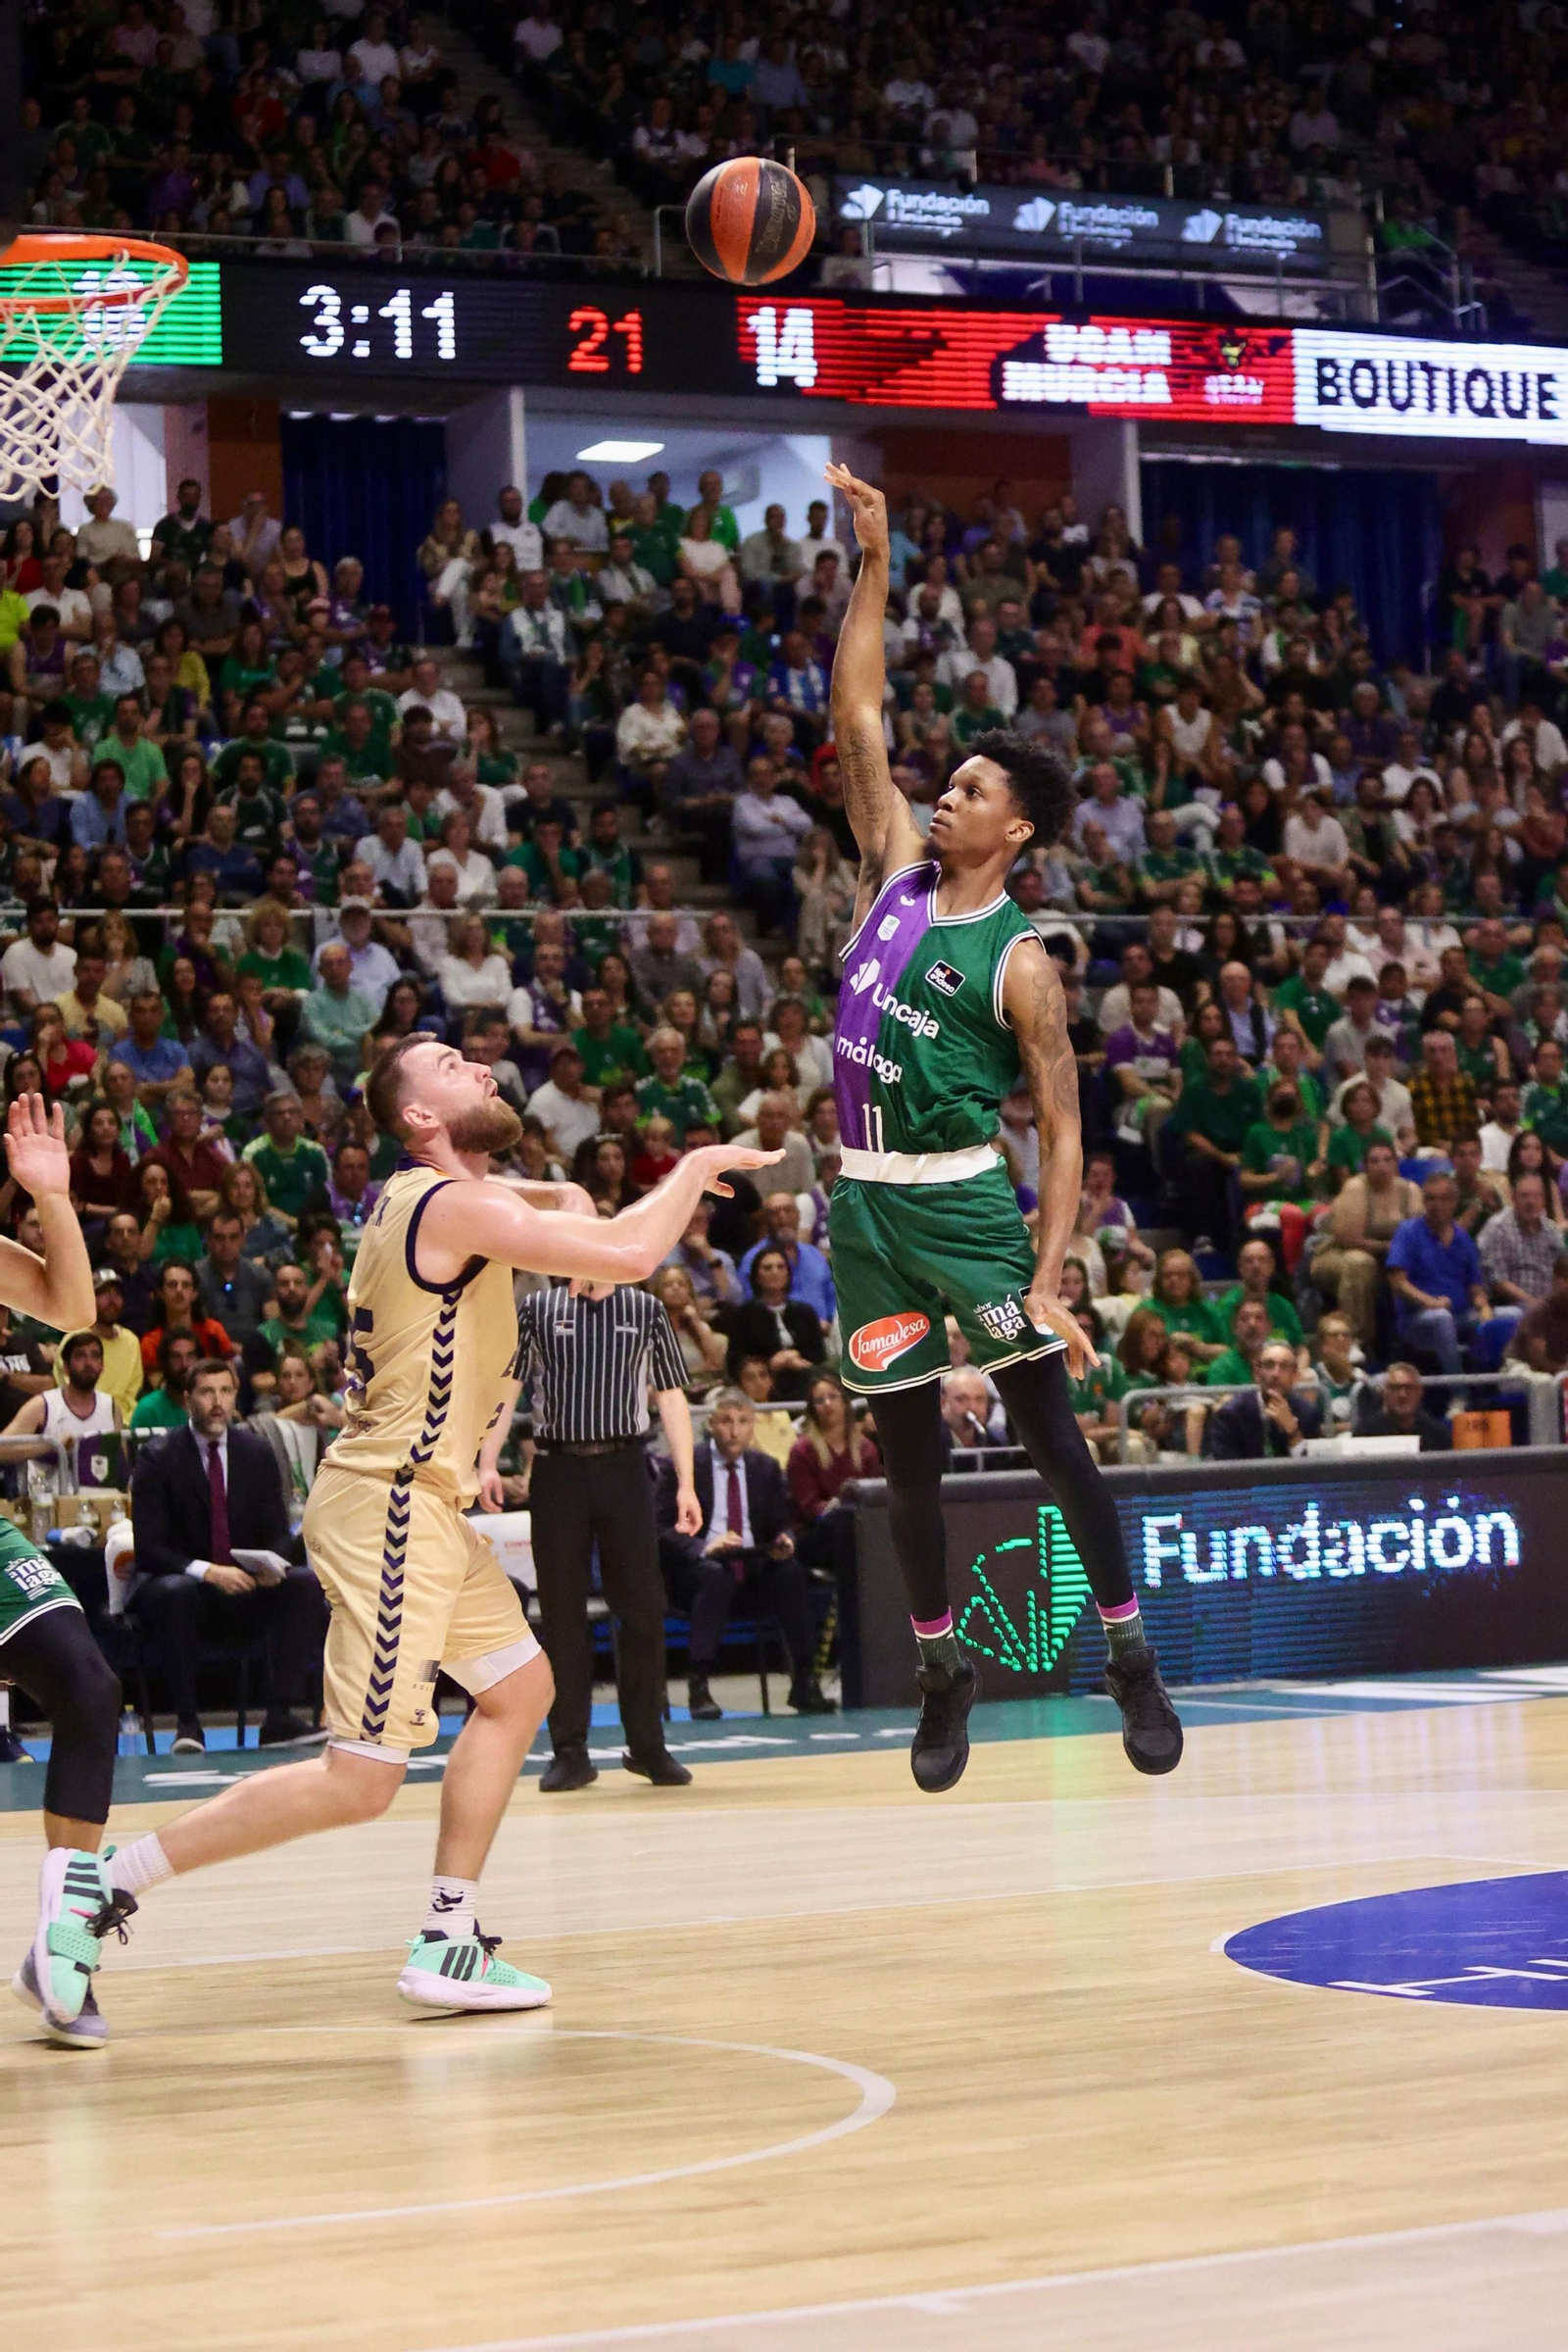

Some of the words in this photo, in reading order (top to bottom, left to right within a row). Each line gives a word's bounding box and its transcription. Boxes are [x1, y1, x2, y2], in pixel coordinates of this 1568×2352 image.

[299, 284, 456, 360] 3:11
[568, 306, 643, 373] 21
[747, 307, 817, 387] 14
[1002, 361, 1173, 404] MURCIA
[1317, 358, 1562, 420] BOUTIQUE
[862, 1102, 885, 1152] 11
[856, 1318, 926, 1362] famadesa
[1142, 1494, 1522, 1589] Fundación
